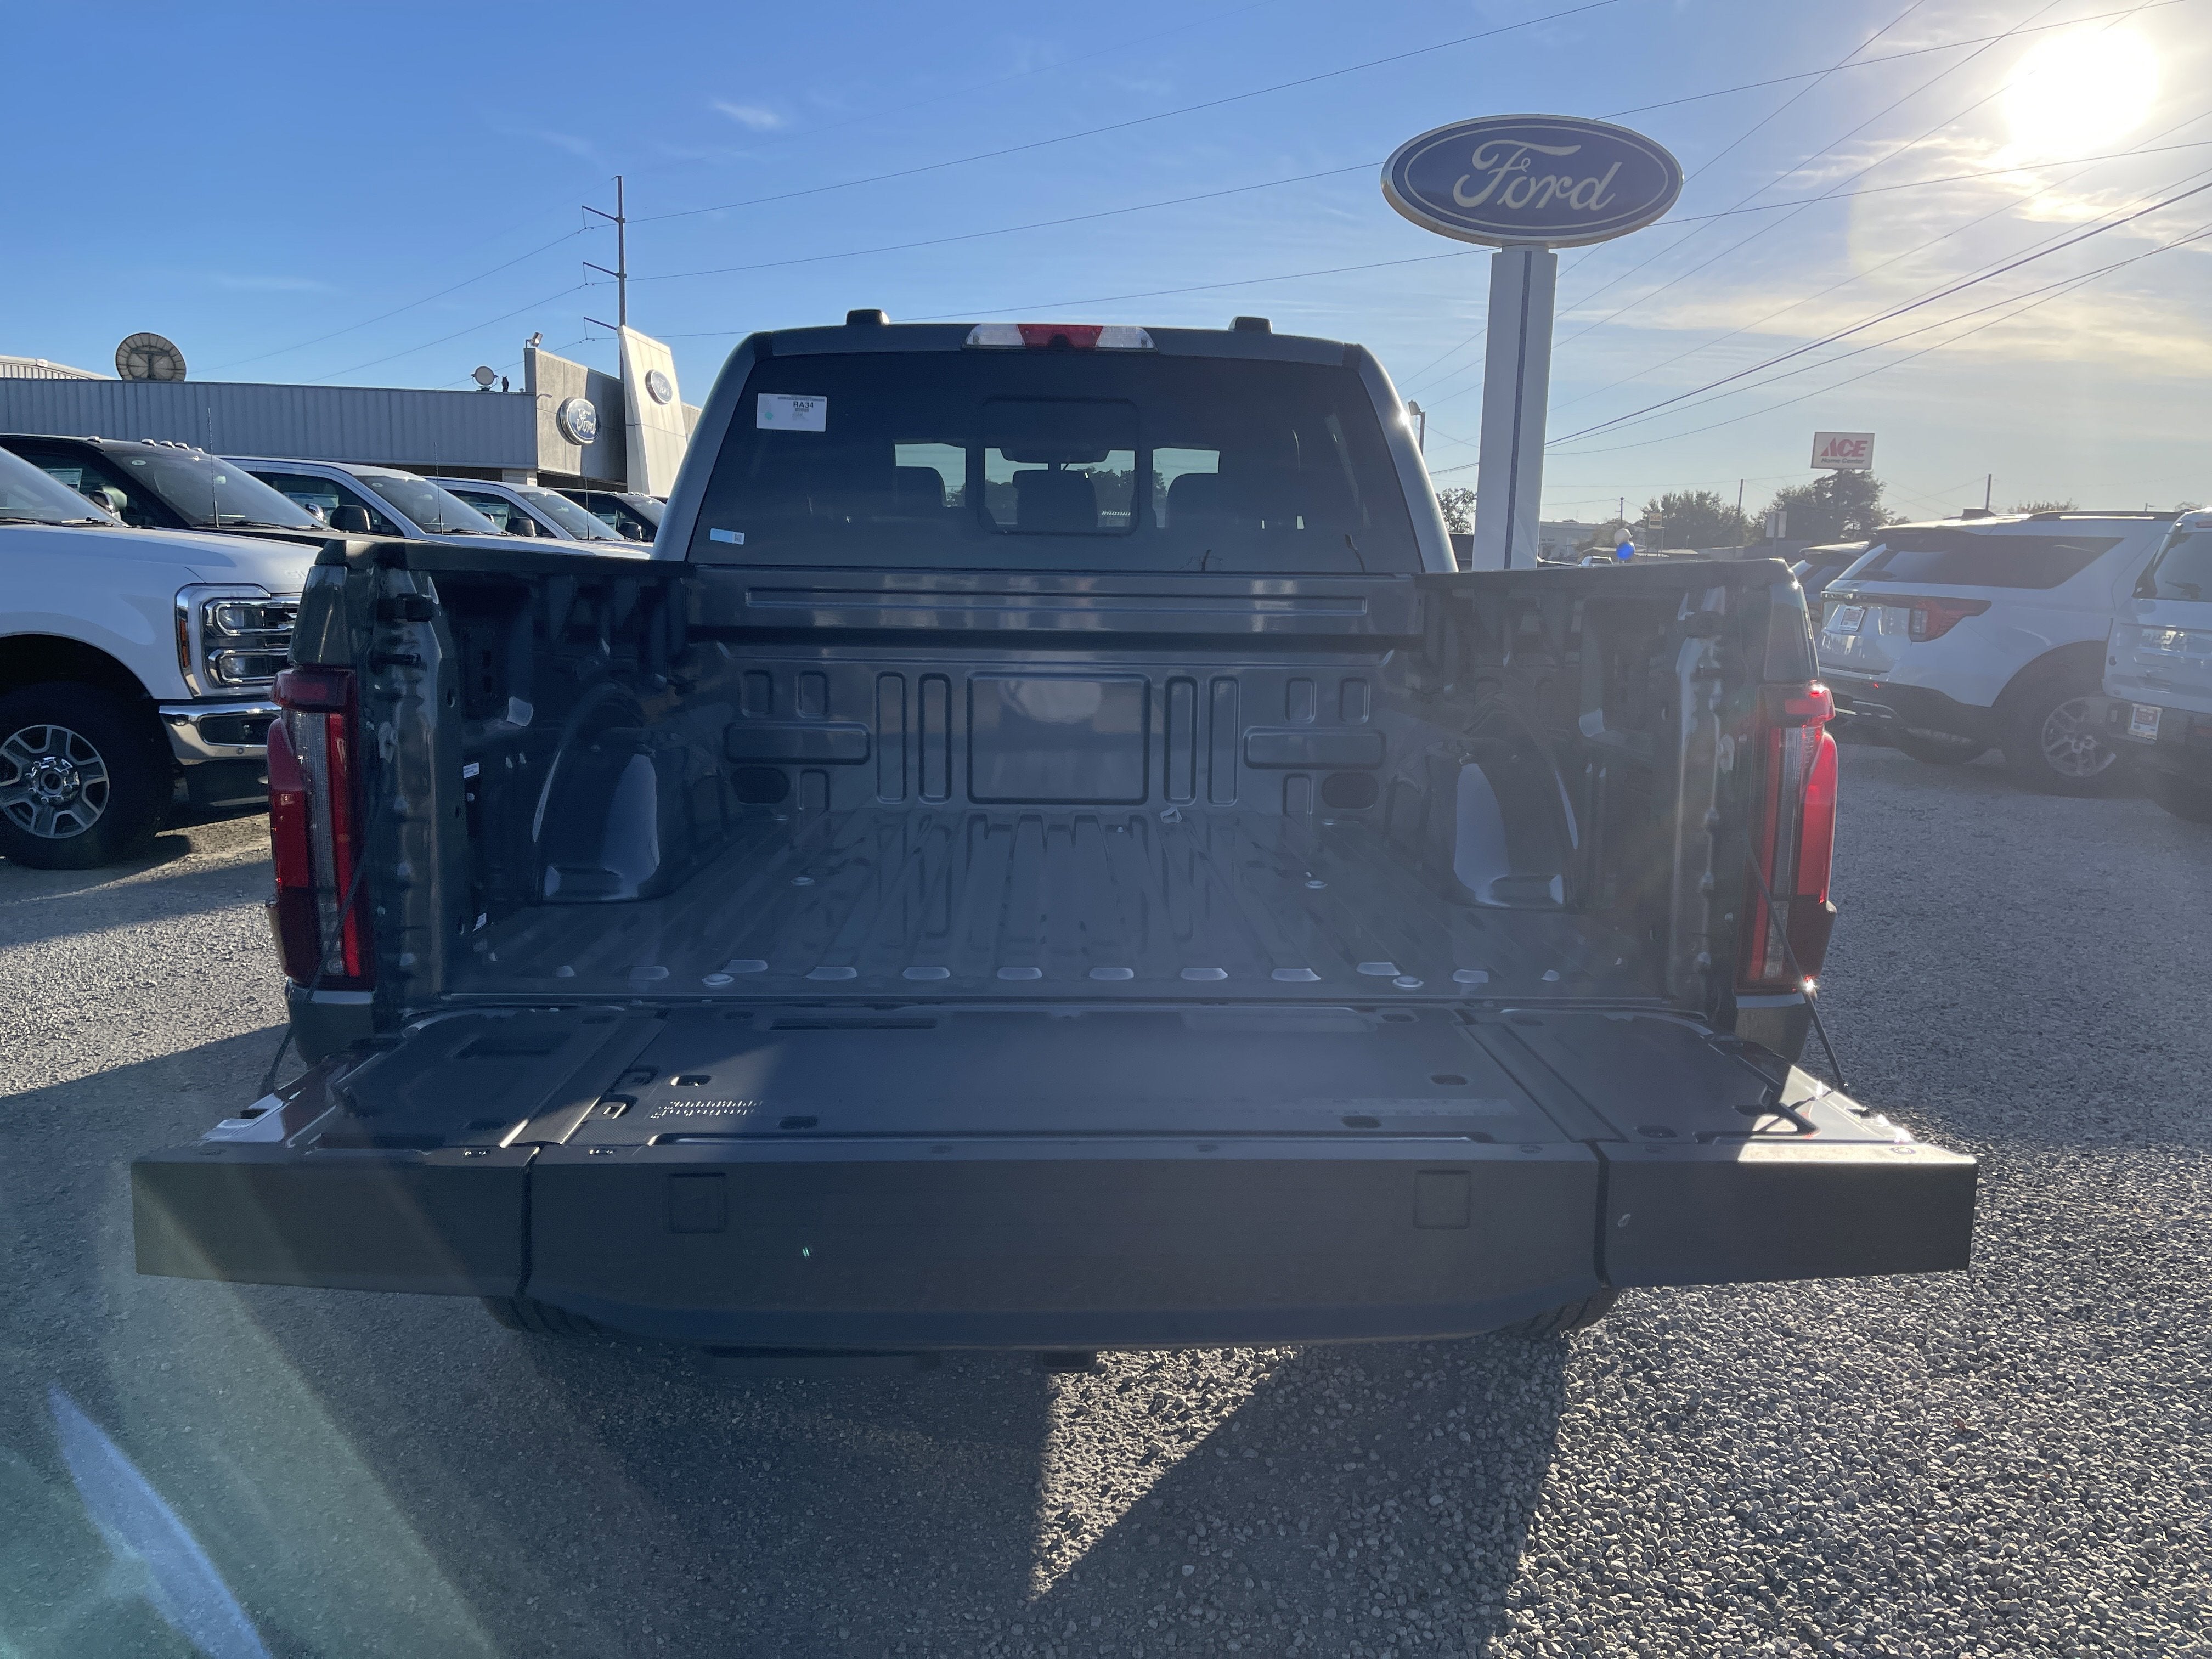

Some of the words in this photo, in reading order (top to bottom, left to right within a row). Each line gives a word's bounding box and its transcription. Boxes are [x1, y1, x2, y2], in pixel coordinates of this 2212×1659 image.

[1453, 139, 1622, 211] Ford
[577, 408, 596, 435] Ford
[1820, 437, 1868, 457] ACE
